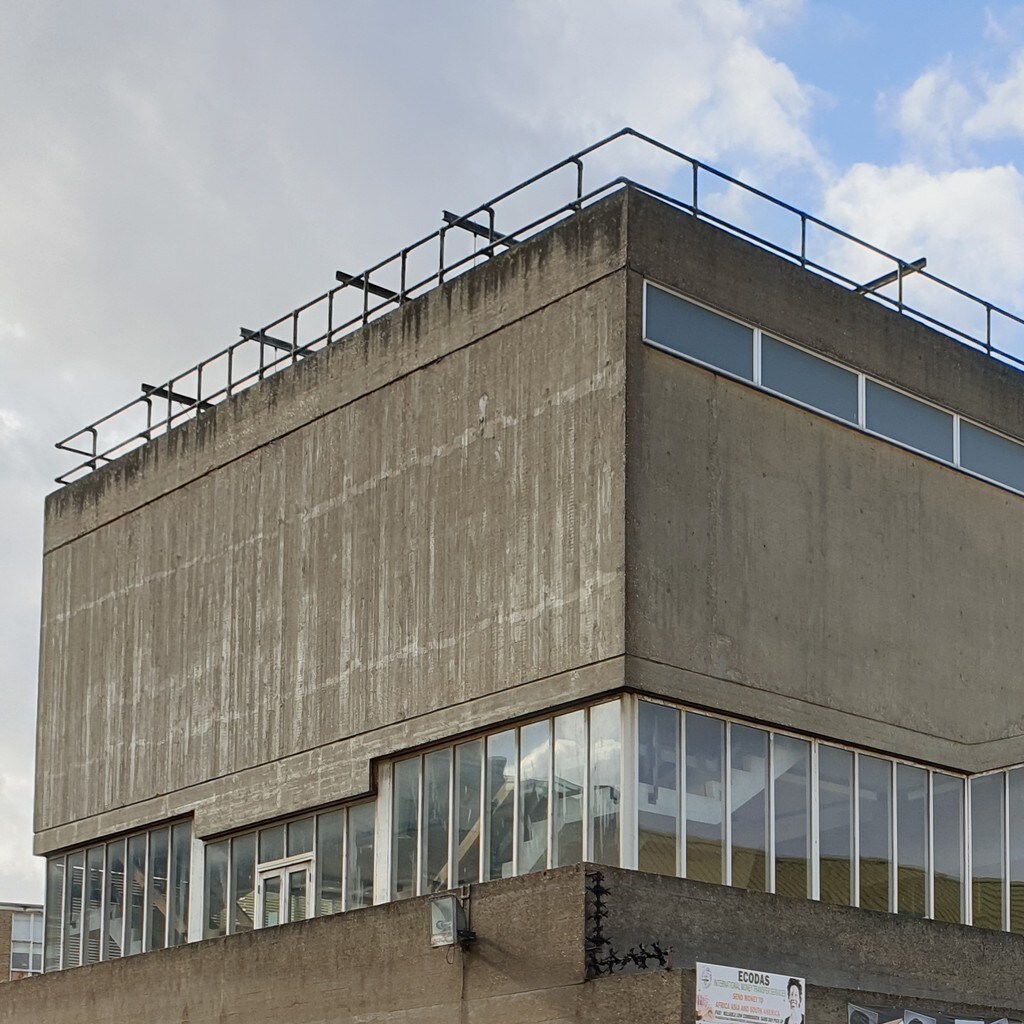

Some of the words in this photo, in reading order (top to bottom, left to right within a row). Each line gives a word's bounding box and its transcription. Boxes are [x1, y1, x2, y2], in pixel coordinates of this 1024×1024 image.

[738, 970, 770, 986] ECODAS
[715, 1001, 730, 1009] AFRICA
[763, 1008, 780, 1016] AMERICA
